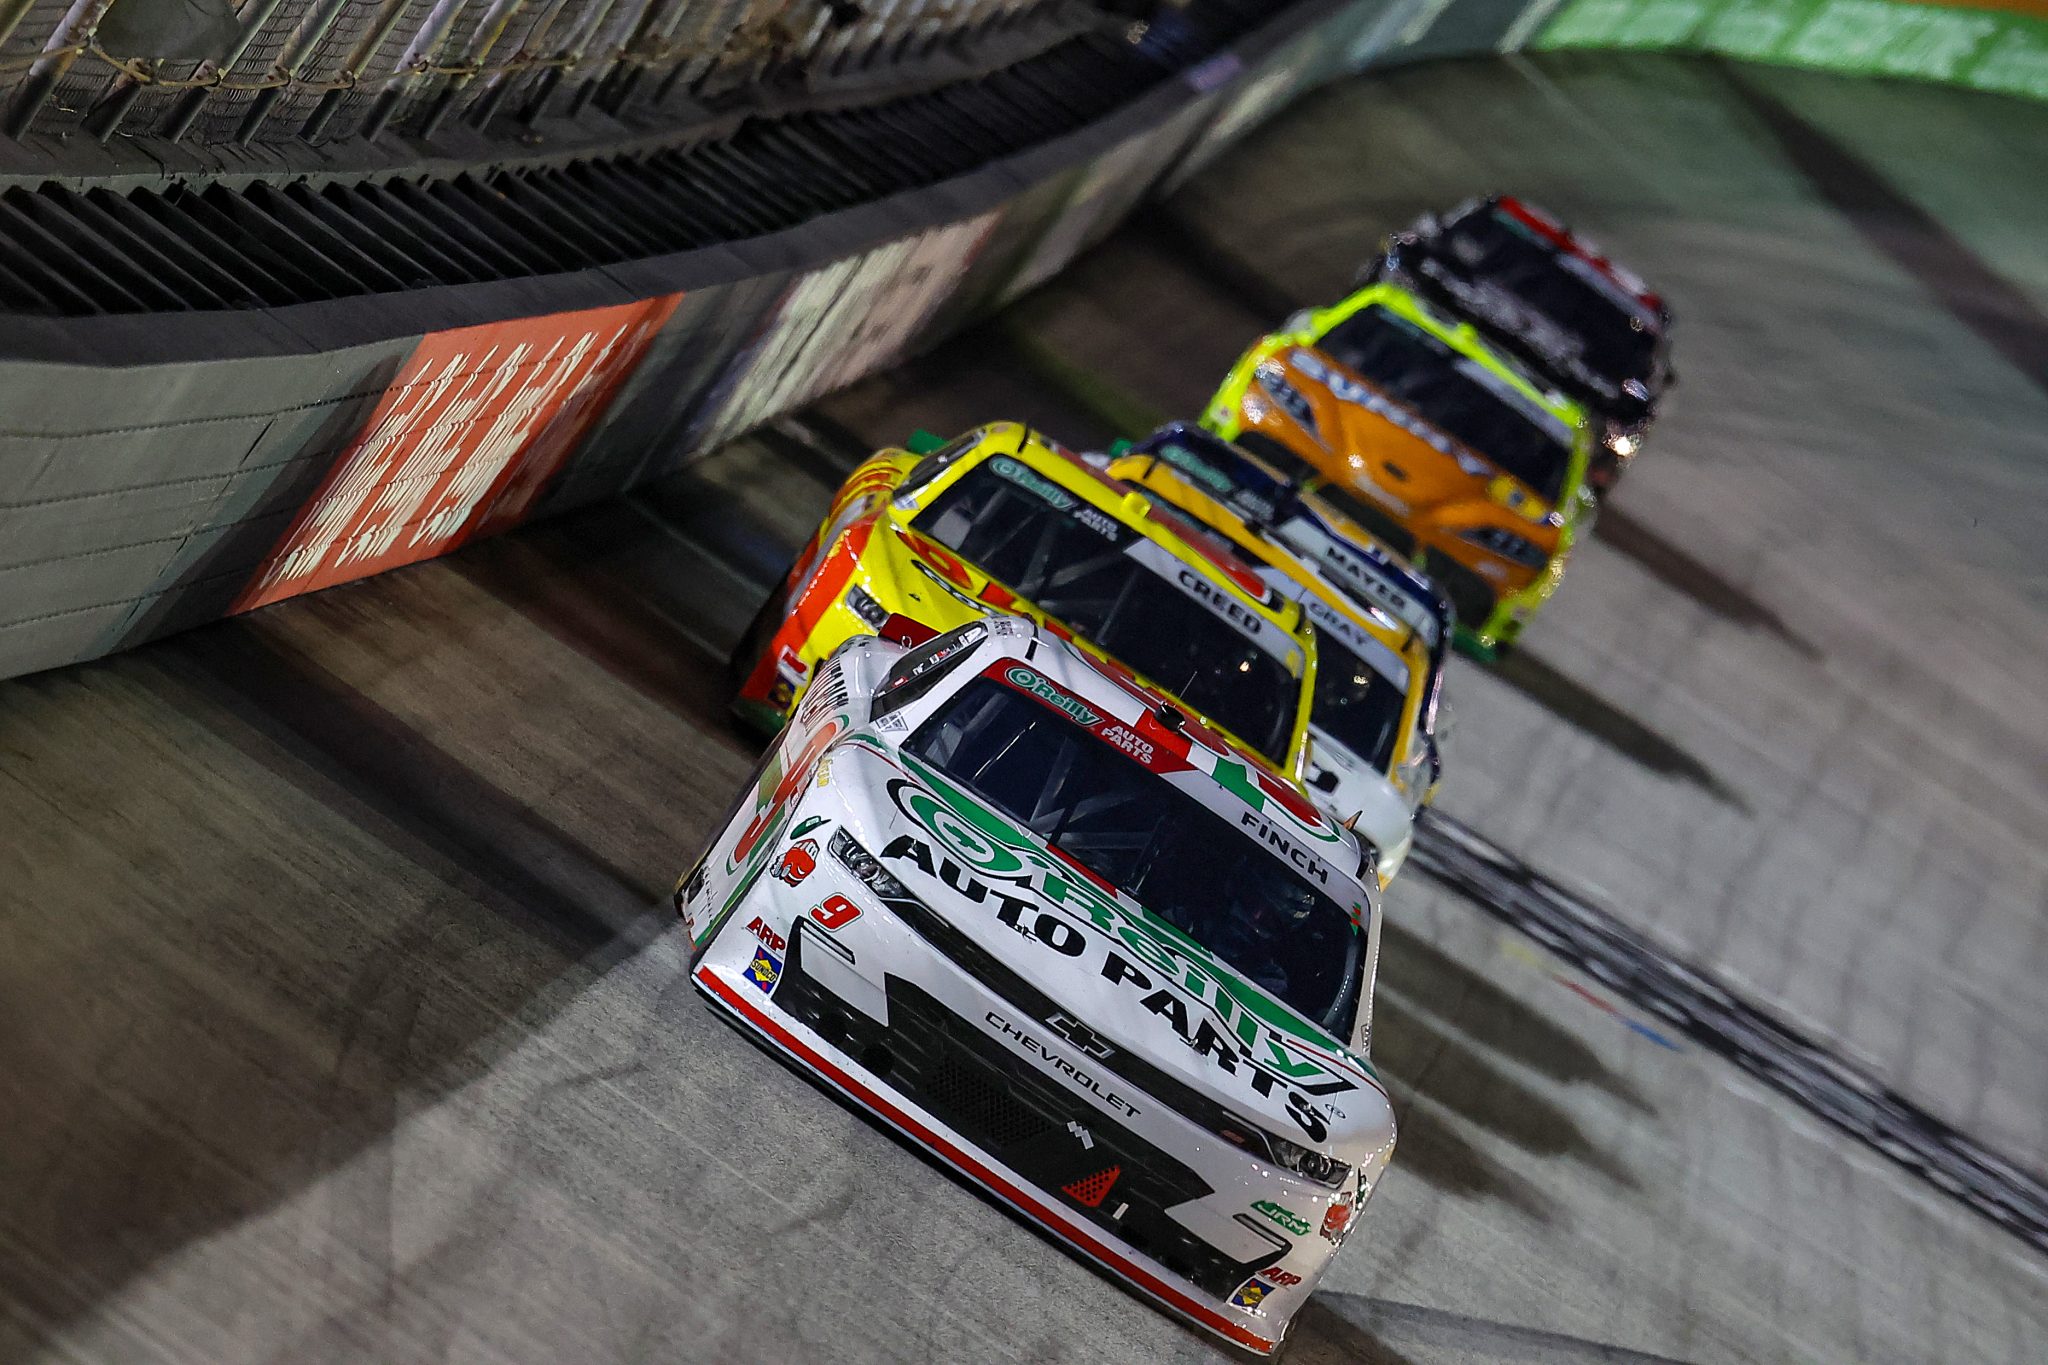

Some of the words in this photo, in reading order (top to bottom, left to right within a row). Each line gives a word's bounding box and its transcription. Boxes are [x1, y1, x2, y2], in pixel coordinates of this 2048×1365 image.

[1178, 570, 1262, 634] CREED
[1326, 546, 1407, 609] MAYER
[1309, 601, 1367, 646] GRAY
[1005, 666, 1106, 727] O'Reilly
[1101, 728, 1153, 764] PARTS
[1112, 725, 1154, 754] AUTO
[1241, 811, 1329, 885] FINCH
[746, 916, 786, 951] ARP
[810, 893, 863, 931] 9
[888, 777, 1359, 1096] O'Reilly
[751, 960, 778, 983] SUNOCO
[880, 834, 1087, 958] AUTO
[1100, 951, 1331, 1143] PARTS
[985, 1010, 1142, 1118] CHEVROLET
